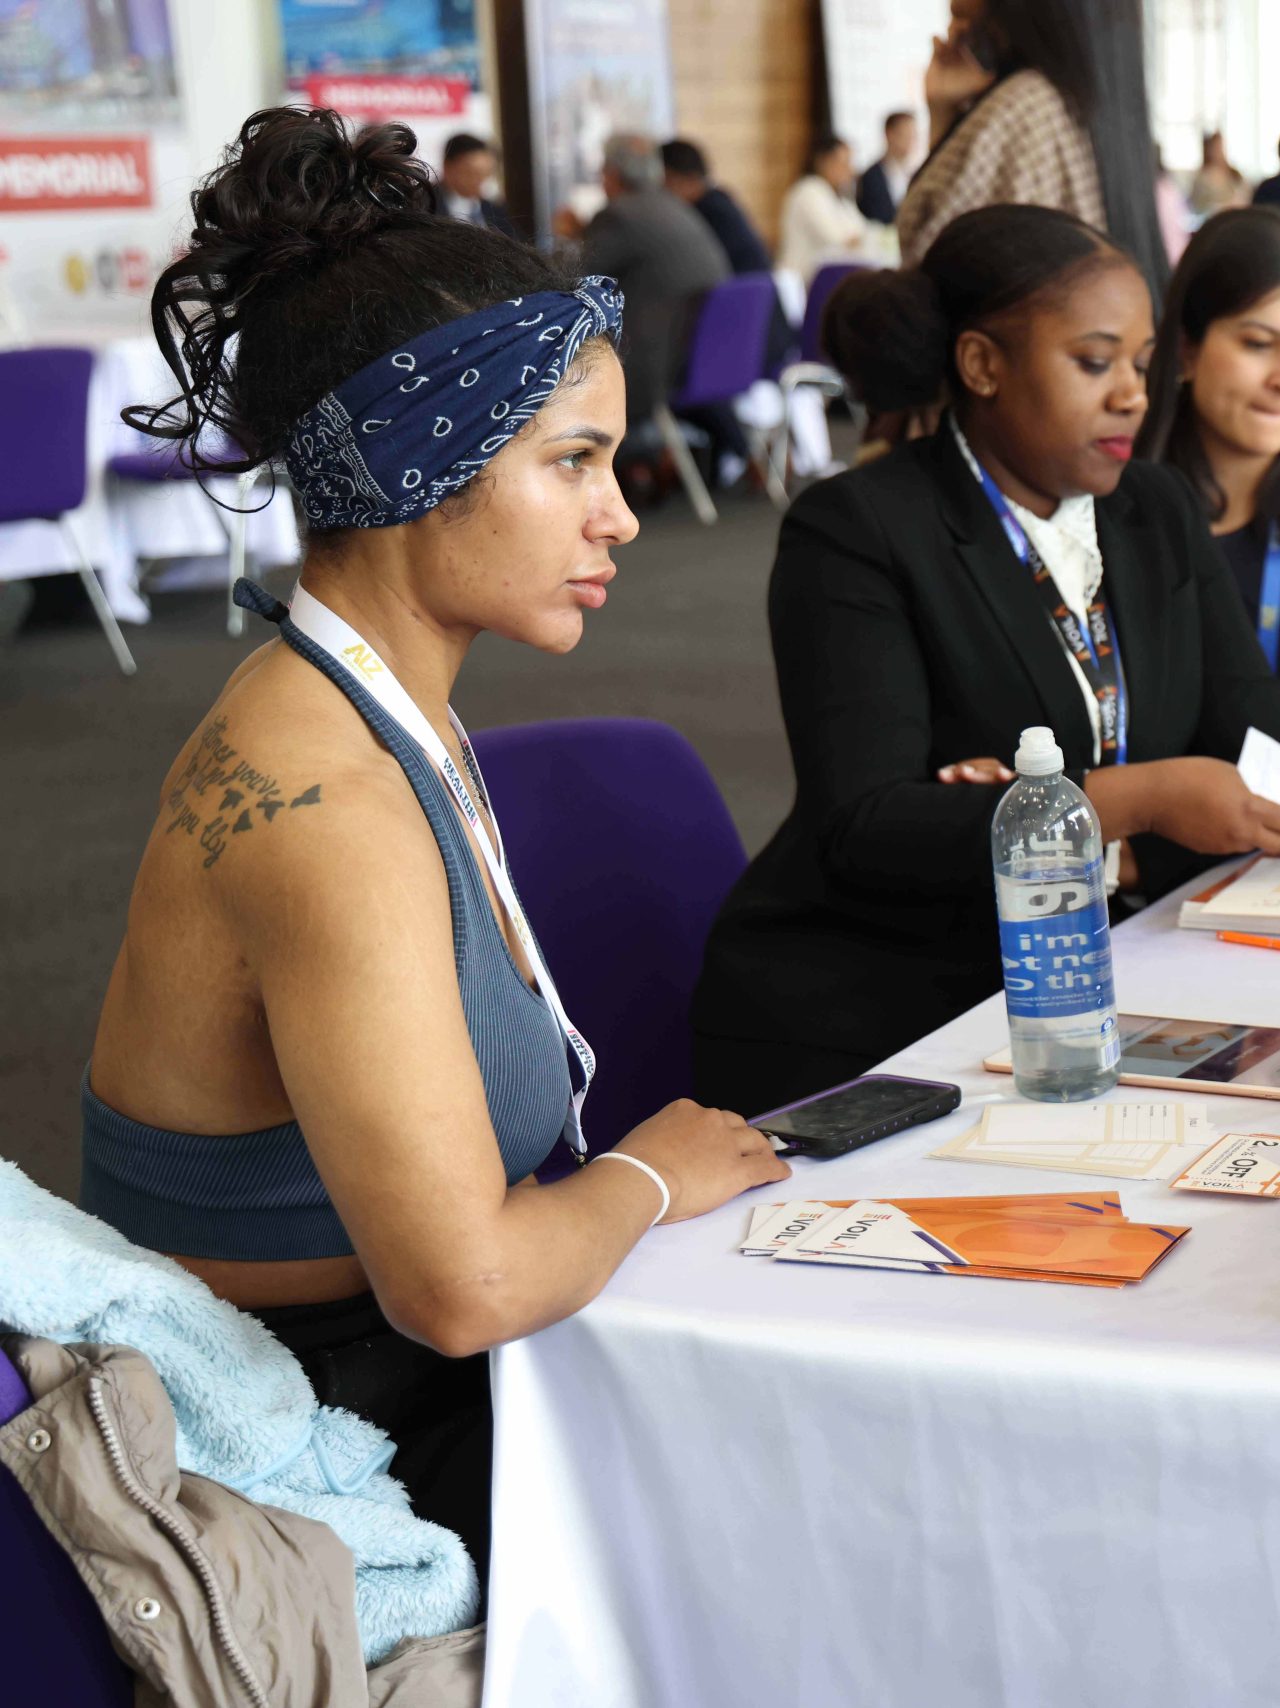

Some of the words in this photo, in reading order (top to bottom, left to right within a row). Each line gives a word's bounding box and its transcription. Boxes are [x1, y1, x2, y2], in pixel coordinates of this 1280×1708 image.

[343, 644, 384, 681] ALZ
[1019, 933, 1088, 951] i'm
[1221, 1158, 1259, 1178] OFF
